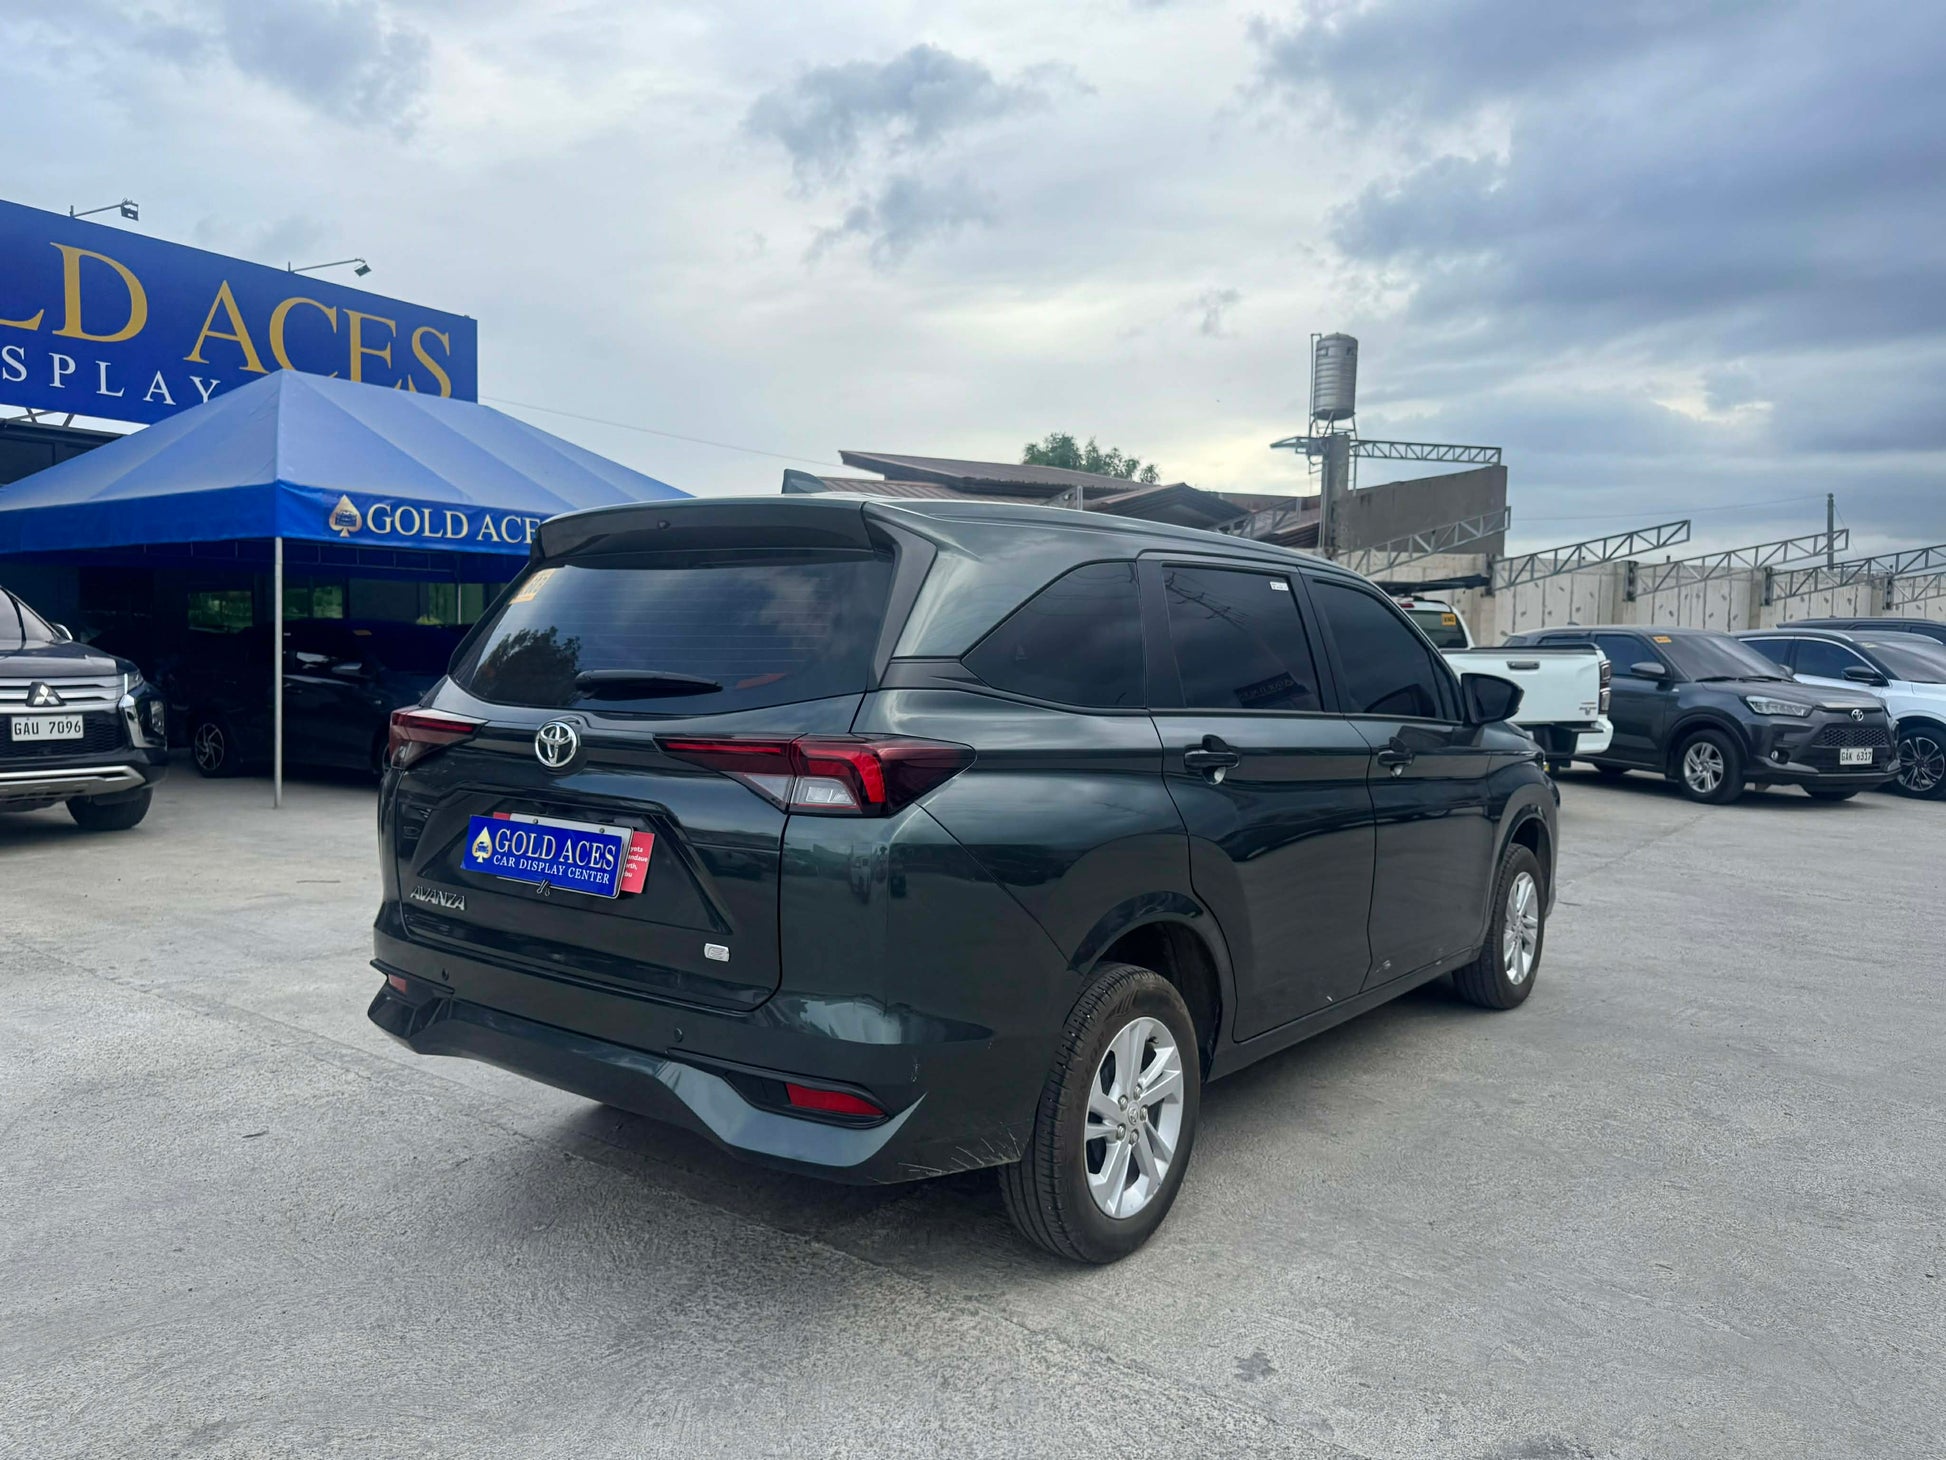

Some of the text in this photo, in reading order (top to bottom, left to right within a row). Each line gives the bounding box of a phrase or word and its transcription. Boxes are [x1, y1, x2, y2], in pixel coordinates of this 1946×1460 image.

[183, 280, 452, 398] ACES
[1, 345, 221, 404] SPLAY
[367, 503, 469, 540] GOLD
[14, 720, 82, 736] GAU 7096
[1856, 751, 1872, 761] 6317
[495, 828, 616, 871] GOLD ACES
[493, 854, 610, 885] CAR DISPLAY CENTER
[410, 885, 465, 911] AVANZA
